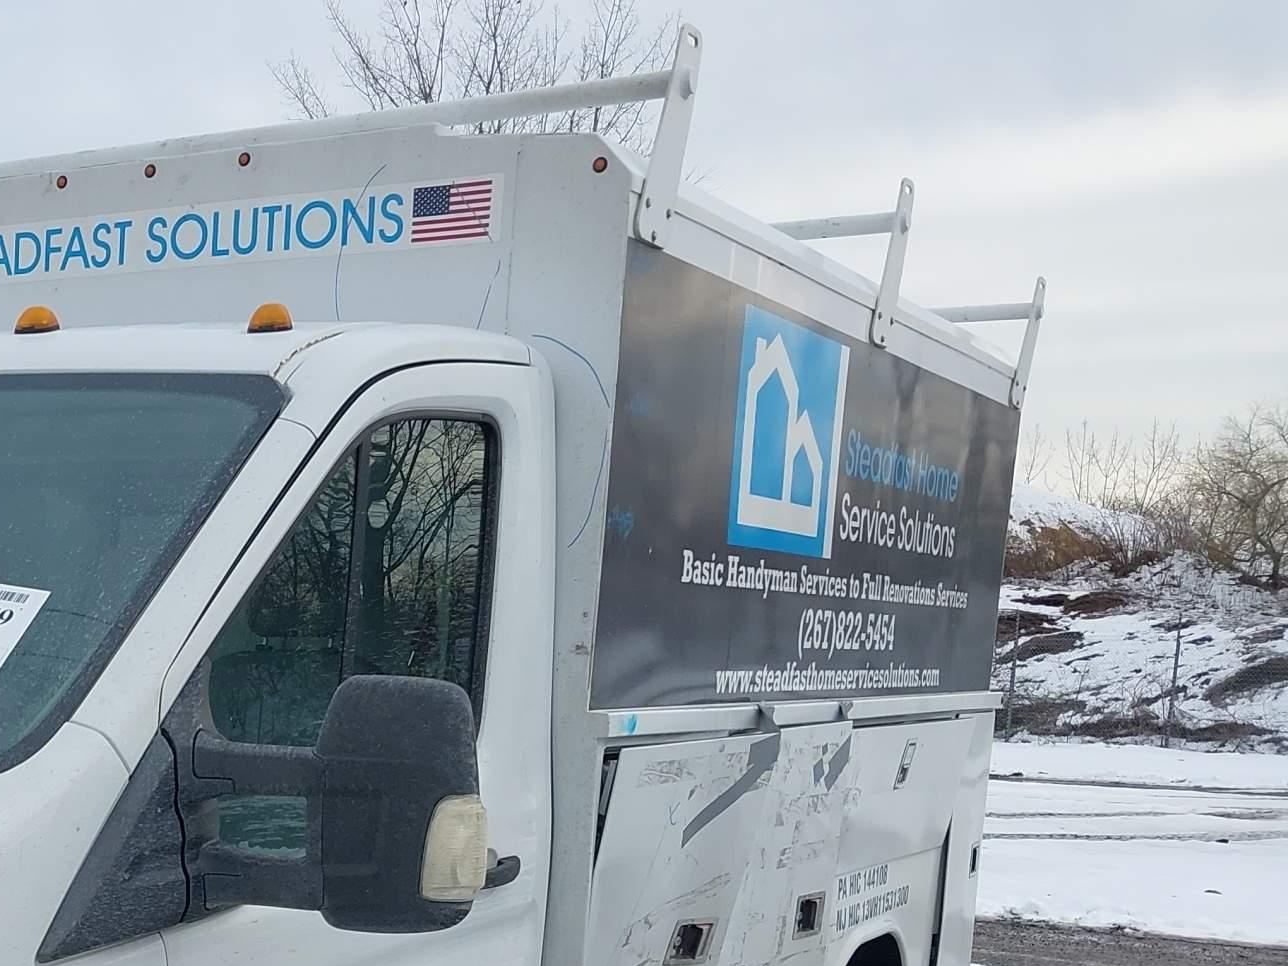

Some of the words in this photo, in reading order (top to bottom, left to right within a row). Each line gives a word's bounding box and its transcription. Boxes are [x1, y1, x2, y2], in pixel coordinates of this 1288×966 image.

[146, 192, 405, 264] SOLUTIONS
[845, 428, 916, 492] Steadfast
[916, 450, 959, 502] Home
[839, 492, 896, 548] Service
[897, 505, 955, 558] Solutions
[681, 549, 724, 588] Basic
[725, 554, 798, 599] Handyman
[799, 564, 848, 598] Services
[849, 573, 861, 599] to
[861, 572, 882, 602] Full
[881, 575, 936, 608] Renovations
[935, 581, 969, 609] Services
[798, 608, 896, 660] (267)822-5454
[715, 660, 940, 695] www.steadfasthomeservicesolutions.com
[838, 877, 848, 900] PA
[849, 871, 861, 896] HIC
[848, 902, 861, 928] HIC
